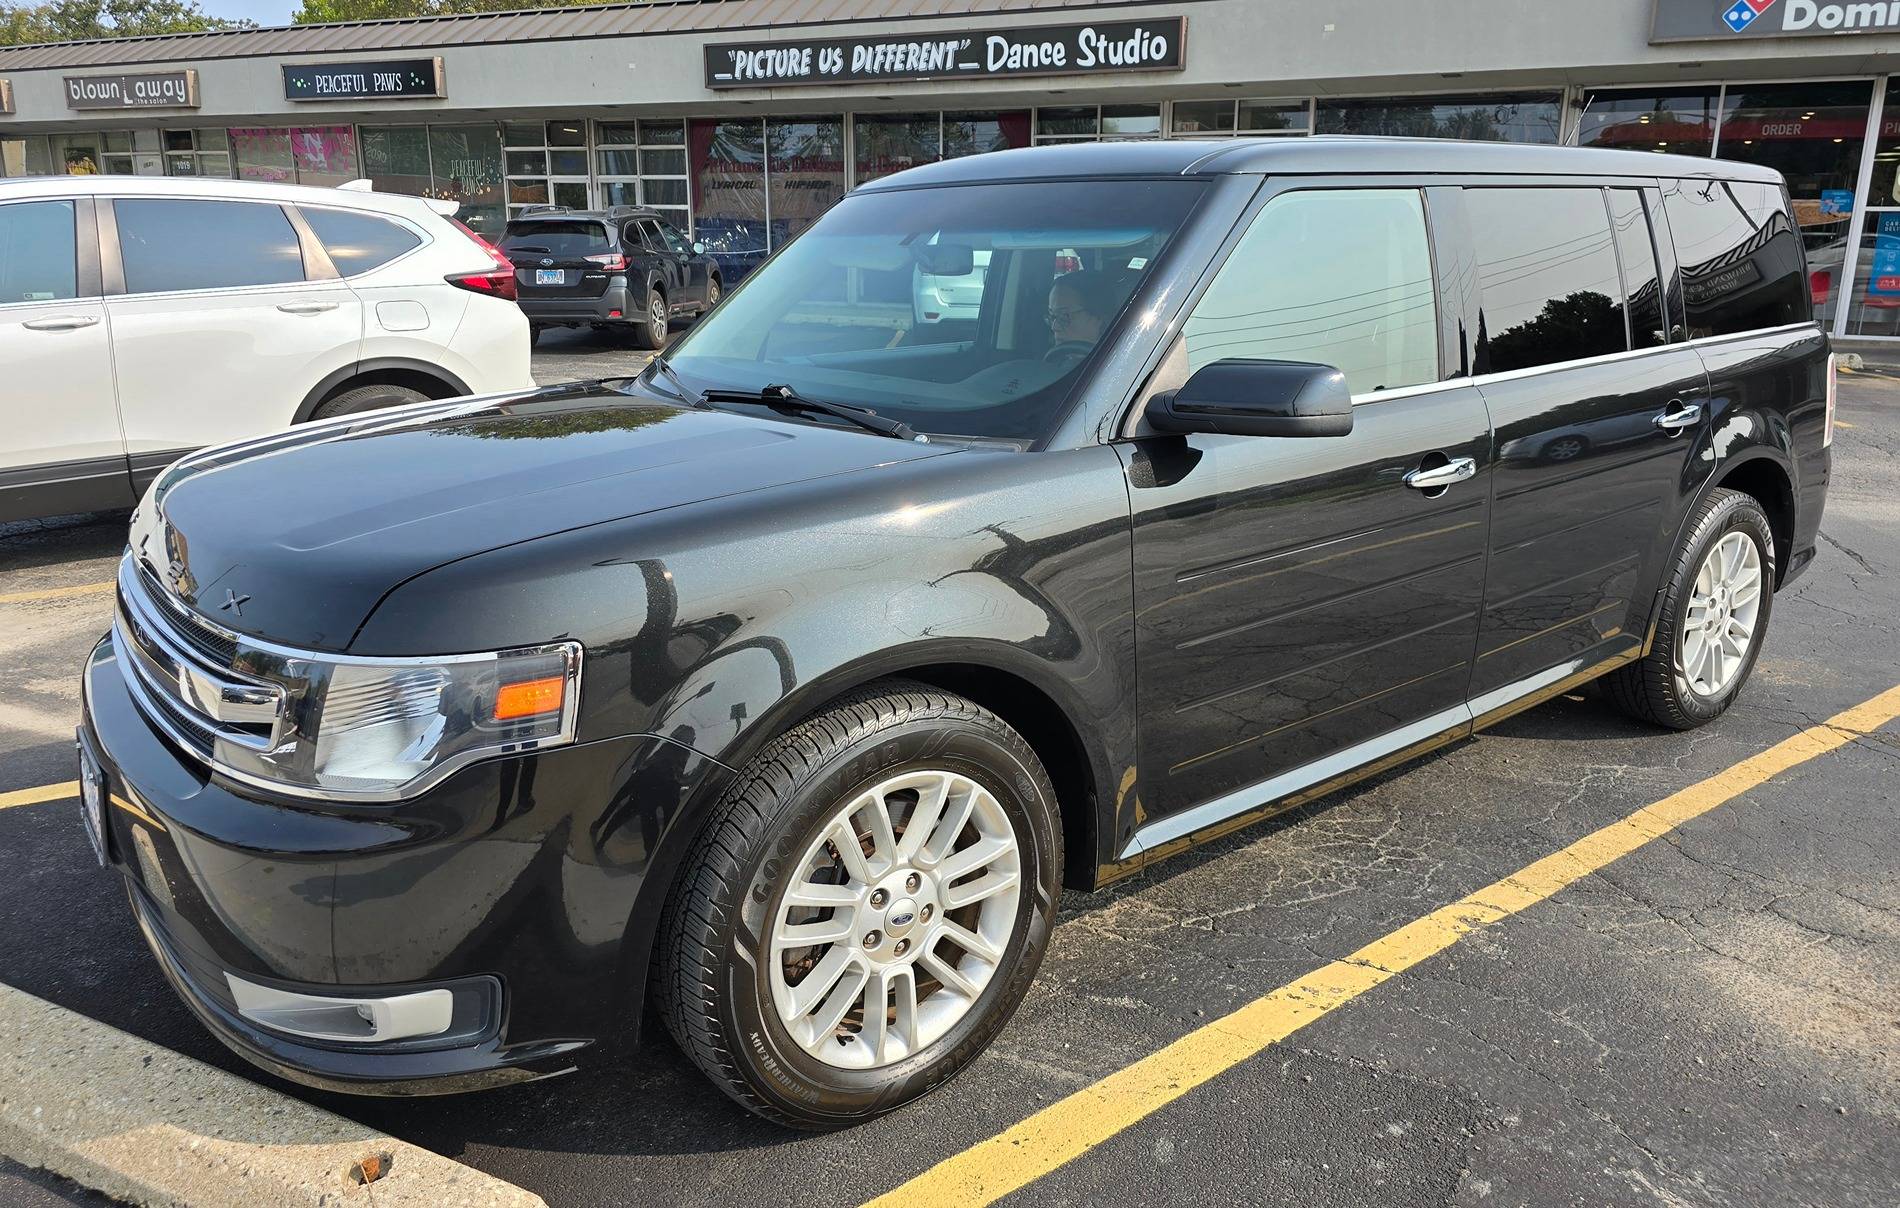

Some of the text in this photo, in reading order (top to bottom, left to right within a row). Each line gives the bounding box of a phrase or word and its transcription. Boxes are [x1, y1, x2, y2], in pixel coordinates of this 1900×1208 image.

[818, 46, 843, 75] US
[986, 35, 1066, 71] Dance
[1077, 27, 1167, 67] Studio
[69, 79, 186, 103] blown away
[315, 72, 403, 93] PEACEFUL PAWS
[1762, 123, 1802, 136] ORDER
[450, 159, 484, 177] PEACEFUL
[461, 176, 481, 194] PAWS
[711, 179, 757, 190] LYRICAL
